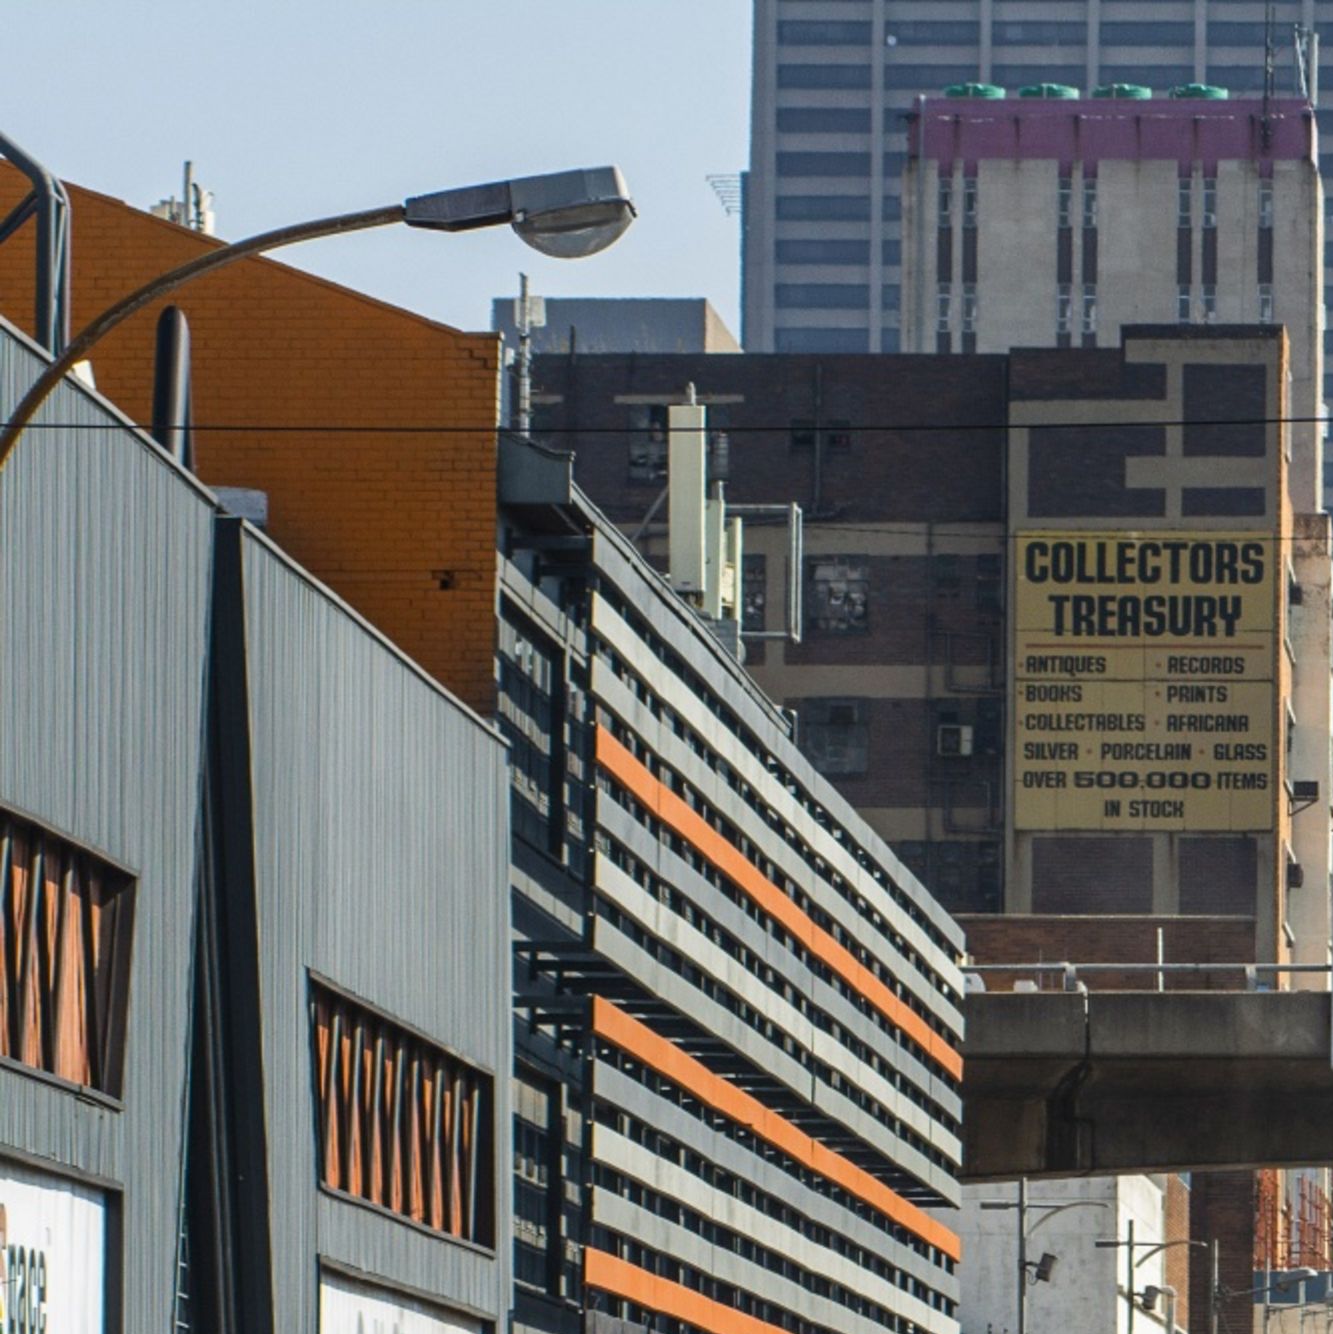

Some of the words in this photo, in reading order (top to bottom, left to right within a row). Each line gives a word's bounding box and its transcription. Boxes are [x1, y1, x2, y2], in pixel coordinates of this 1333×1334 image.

[1025, 541, 1264, 584] COLLECTORS
[1047, 594, 1242, 637] TREASURY
[1026, 655, 1106, 677] ANTIQUES
[1167, 656, 1245, 674] RECORDS
[1025, 685, 1082, 703] BOOKS
[1166, 686, 1228, 703] PRINTS
[1025, 714, 1145, 731] COLLECTABLES
[1166, 715, 1249, 732] AFRICANA
[1023, 743, 1079, 760] SILVER
[1101, 743, 1192, 760] PORCELAIN
[1213, 743, 1267, 761] GLASS
[1023, 771, 1067, 789] OVER
[1217, 772, 1268, 790] ITEMS
[1104, 801, 1121, 818] IN
[1129, 801, 1184, 818] STOCK
